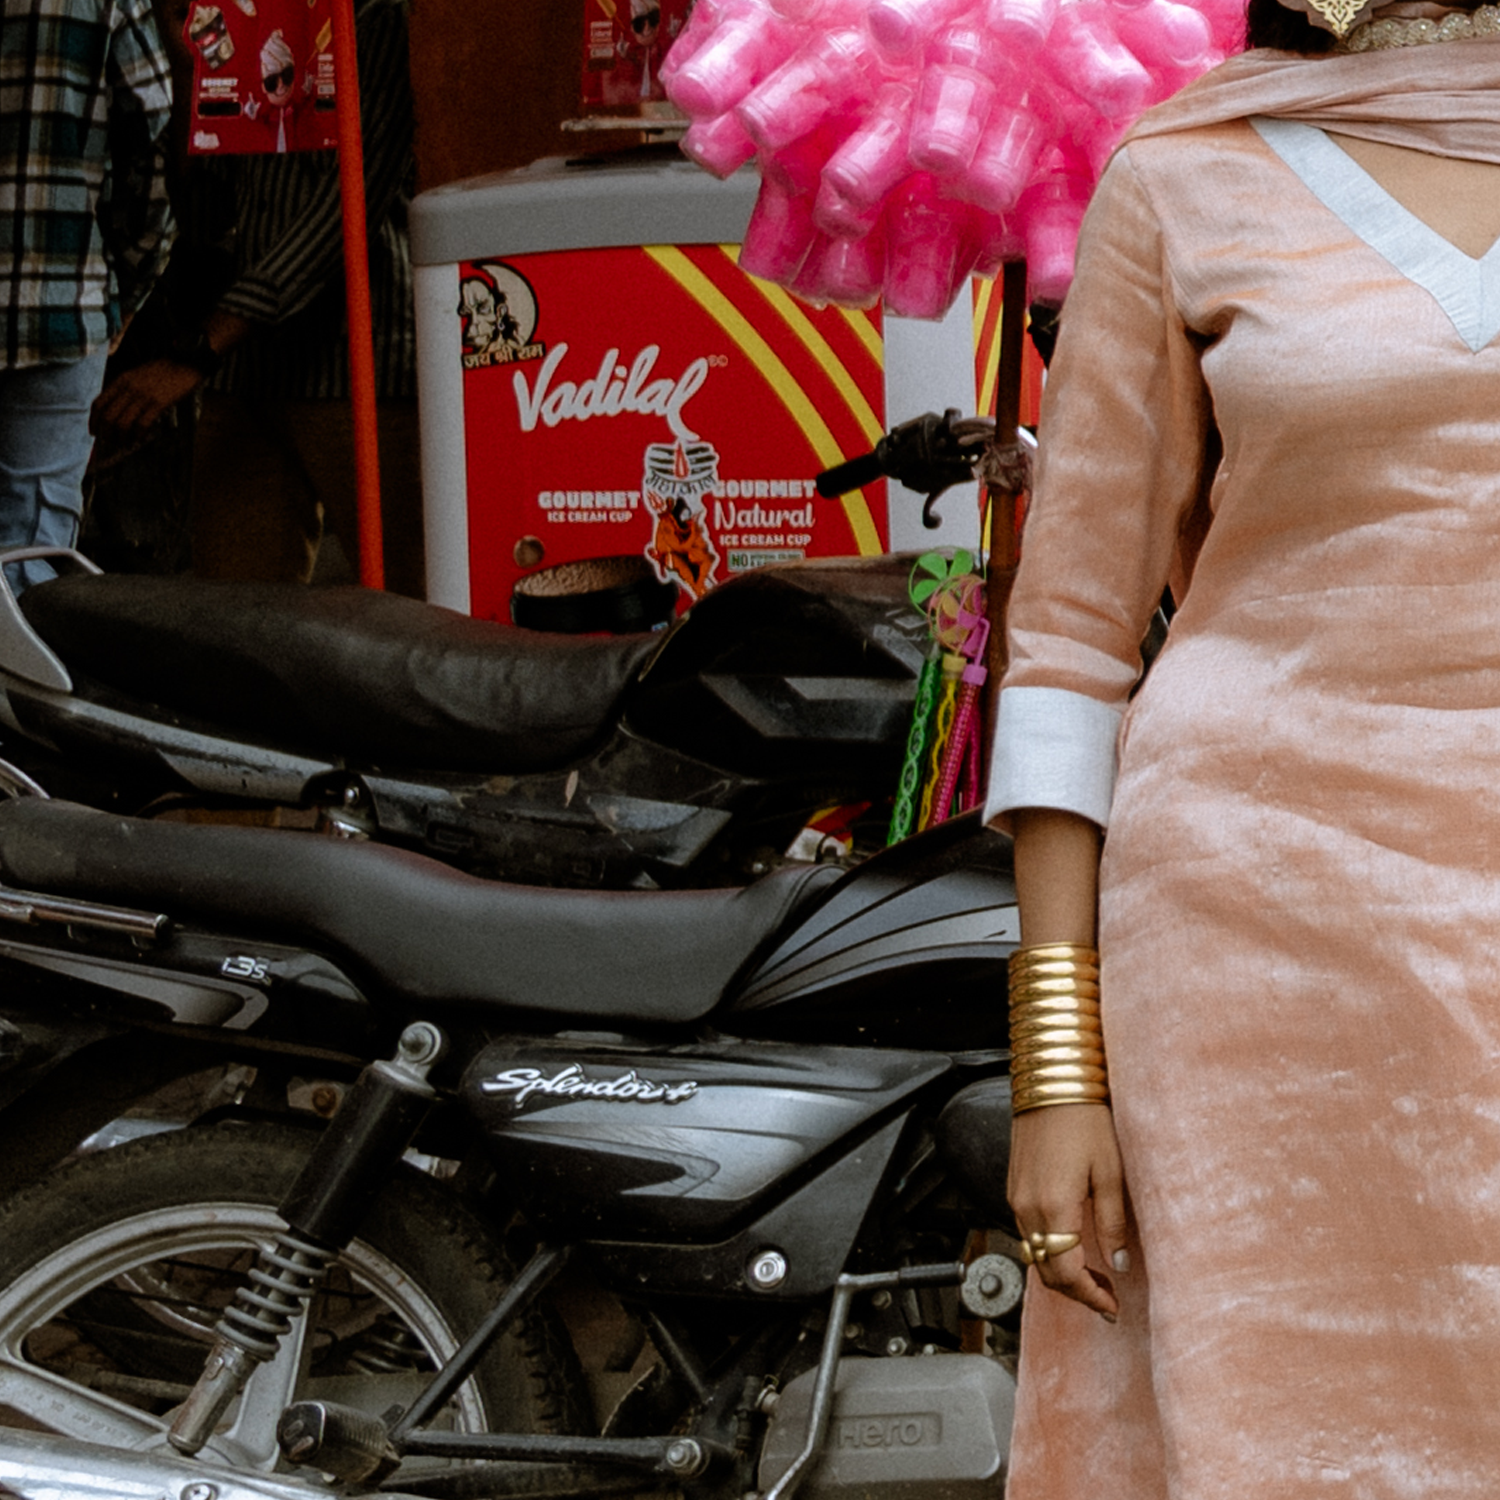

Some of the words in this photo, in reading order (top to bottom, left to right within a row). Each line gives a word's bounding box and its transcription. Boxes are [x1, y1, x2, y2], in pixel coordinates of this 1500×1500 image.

[464, 353, 491, 369] जय
[512, 341, 709, 443] Vadilal
[712, 479, 817, 498] GOURMET
[538, 490, 641, 509] GOURMET
[547, 510, 566, 523] ICE
[567, 510, 607, 523] CREAM
[608, 510, 632, 523] CUP
[714, 499, 816, 531] Natural
[719, 533, 739, 547] ICE
[741, 533, 784, 547] CREAM
[786, 533, 811, 547] CUP
[838, 1420, 922, 1449] Hero
